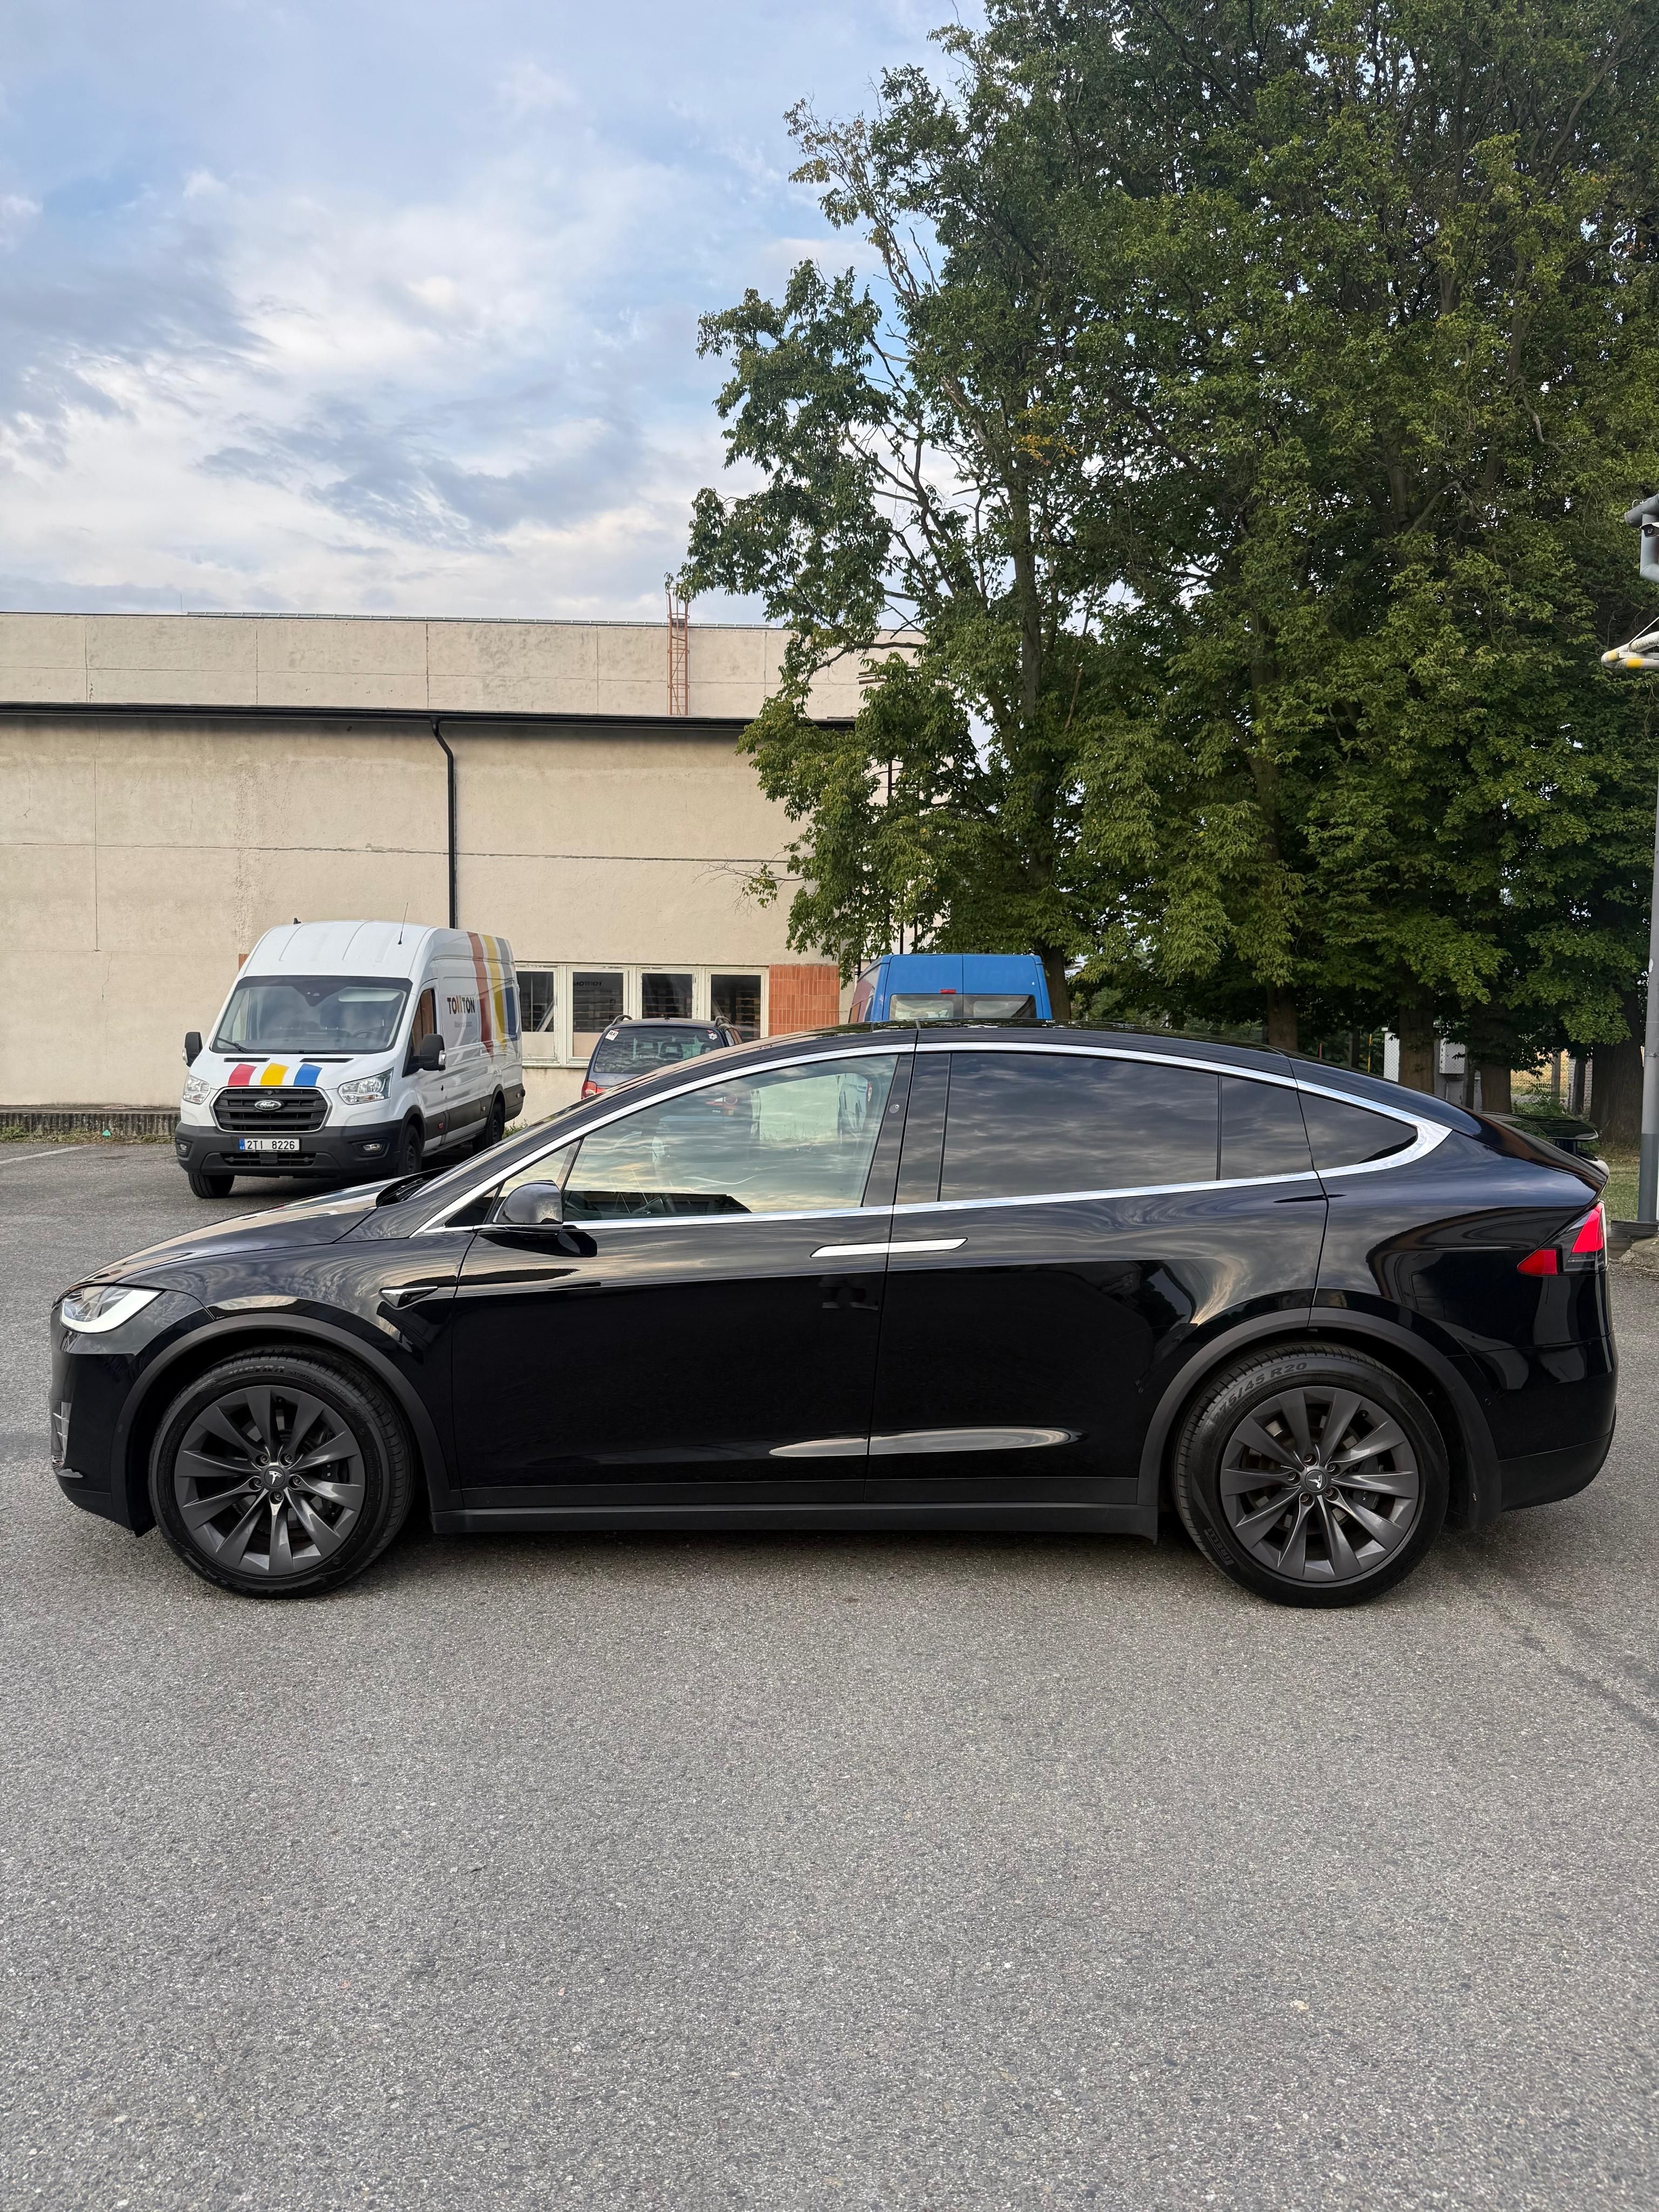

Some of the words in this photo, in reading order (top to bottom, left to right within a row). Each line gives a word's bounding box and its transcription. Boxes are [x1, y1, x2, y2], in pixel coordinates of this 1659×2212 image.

[247, 1140, 263, 1149] 2TI
[272, 1141, 295, 1149] 8226
[1270, 1362, 1307, 1378] R20
